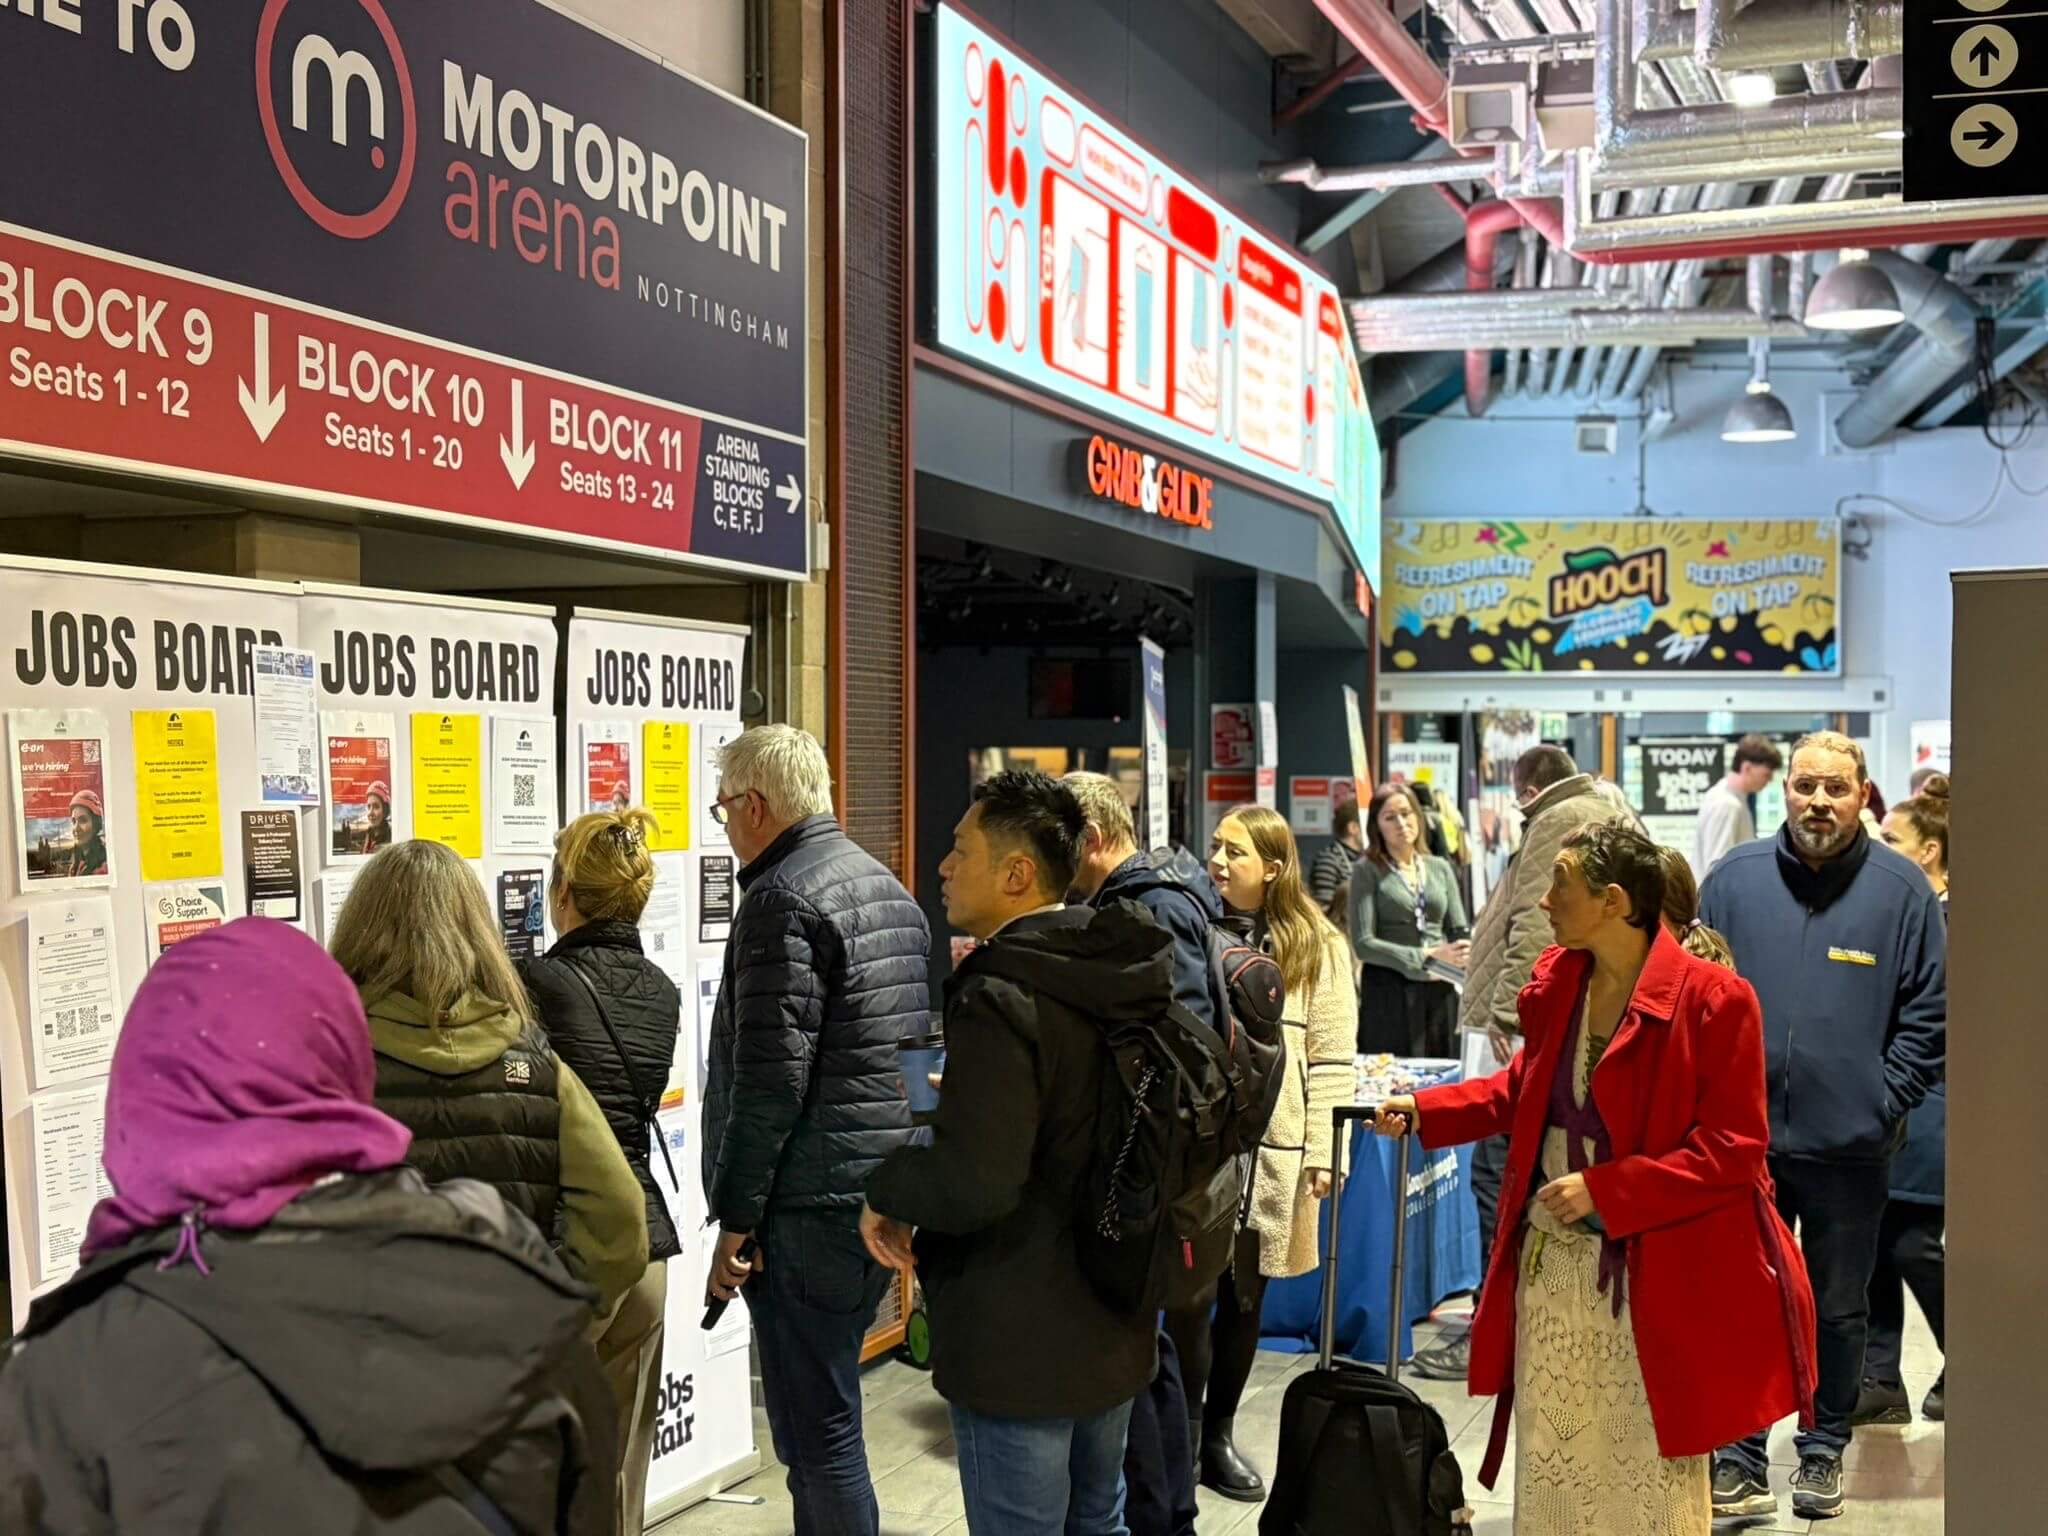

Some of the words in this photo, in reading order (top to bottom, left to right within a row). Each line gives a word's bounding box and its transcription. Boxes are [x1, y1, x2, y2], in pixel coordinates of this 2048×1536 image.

[118, 0, 195, 71] TO
[443, 58, 788, 273] MOTORPOINT
[445, 160, 621, 291] arena
[0, 260, 169, 358] BLOCK
[183, 307, 213, 366] 9
[638, 274, 789, 350] NOTTINGHAM
[9, 346, 104, 402] Seats
[113, 368, 127, 406] 1
[156, 377, 190, 418] 12
[298, 334, 437, 417] BLOCK
[446, 374, 485, 427] 10
[324, 411, 394, 458] Seats
[401, 427, 411, 461] 1
[432, 434, 464, 470] 20
[550, 398, 652, 466] BLOCK
[659, 426, 683, 472] 11
[716, 433, 761, 463] ARENA
[560, 460, 612, 499] Seats
[617, 473, 637, 504] 13
[651, 480, 675, 511] 24
[706, 455, 770, 489] STANDING
[713, 480, 764, 511] BLOCKS
[714, 505, 727, 531] C,
[729, 510, 742, 533] E,
[744, 512, 755, 535] F,
[756, 517, 764, 534] J
[1394, 553, 1535, 588] REFRESHMENT
[1553, 550, 1667, 616] HOOCH
[1686, 552, 1826, 587] REFRESHMENT
[1420, 591, 1457, 619] ON
[1461, 580, 1509, 611] TAP
[1712, 590, 1748, 618] ON
[1752, 581, 1800, 609] TAP
[16, 610, 138, 690] JOBS
[154, 620, 283, 695] BOAR
[320, 629, 416, 697] JOBS
[431, 637, 540, 702] BOARD
[587, 648, 651, 707] JOBS
[661, 654, 735, 711] BOARD
[45, 760, 70, 773] hiring
[1647, 747, 1718, 767] TODAY
[1656, 767, 1710, 798] jobs
[250, 813, 289, 825] DRIVER
[175, 896, 202, 908] Choice
[176, 906, 208, 918] Support
[655, 1372, 694, 1419] obs
